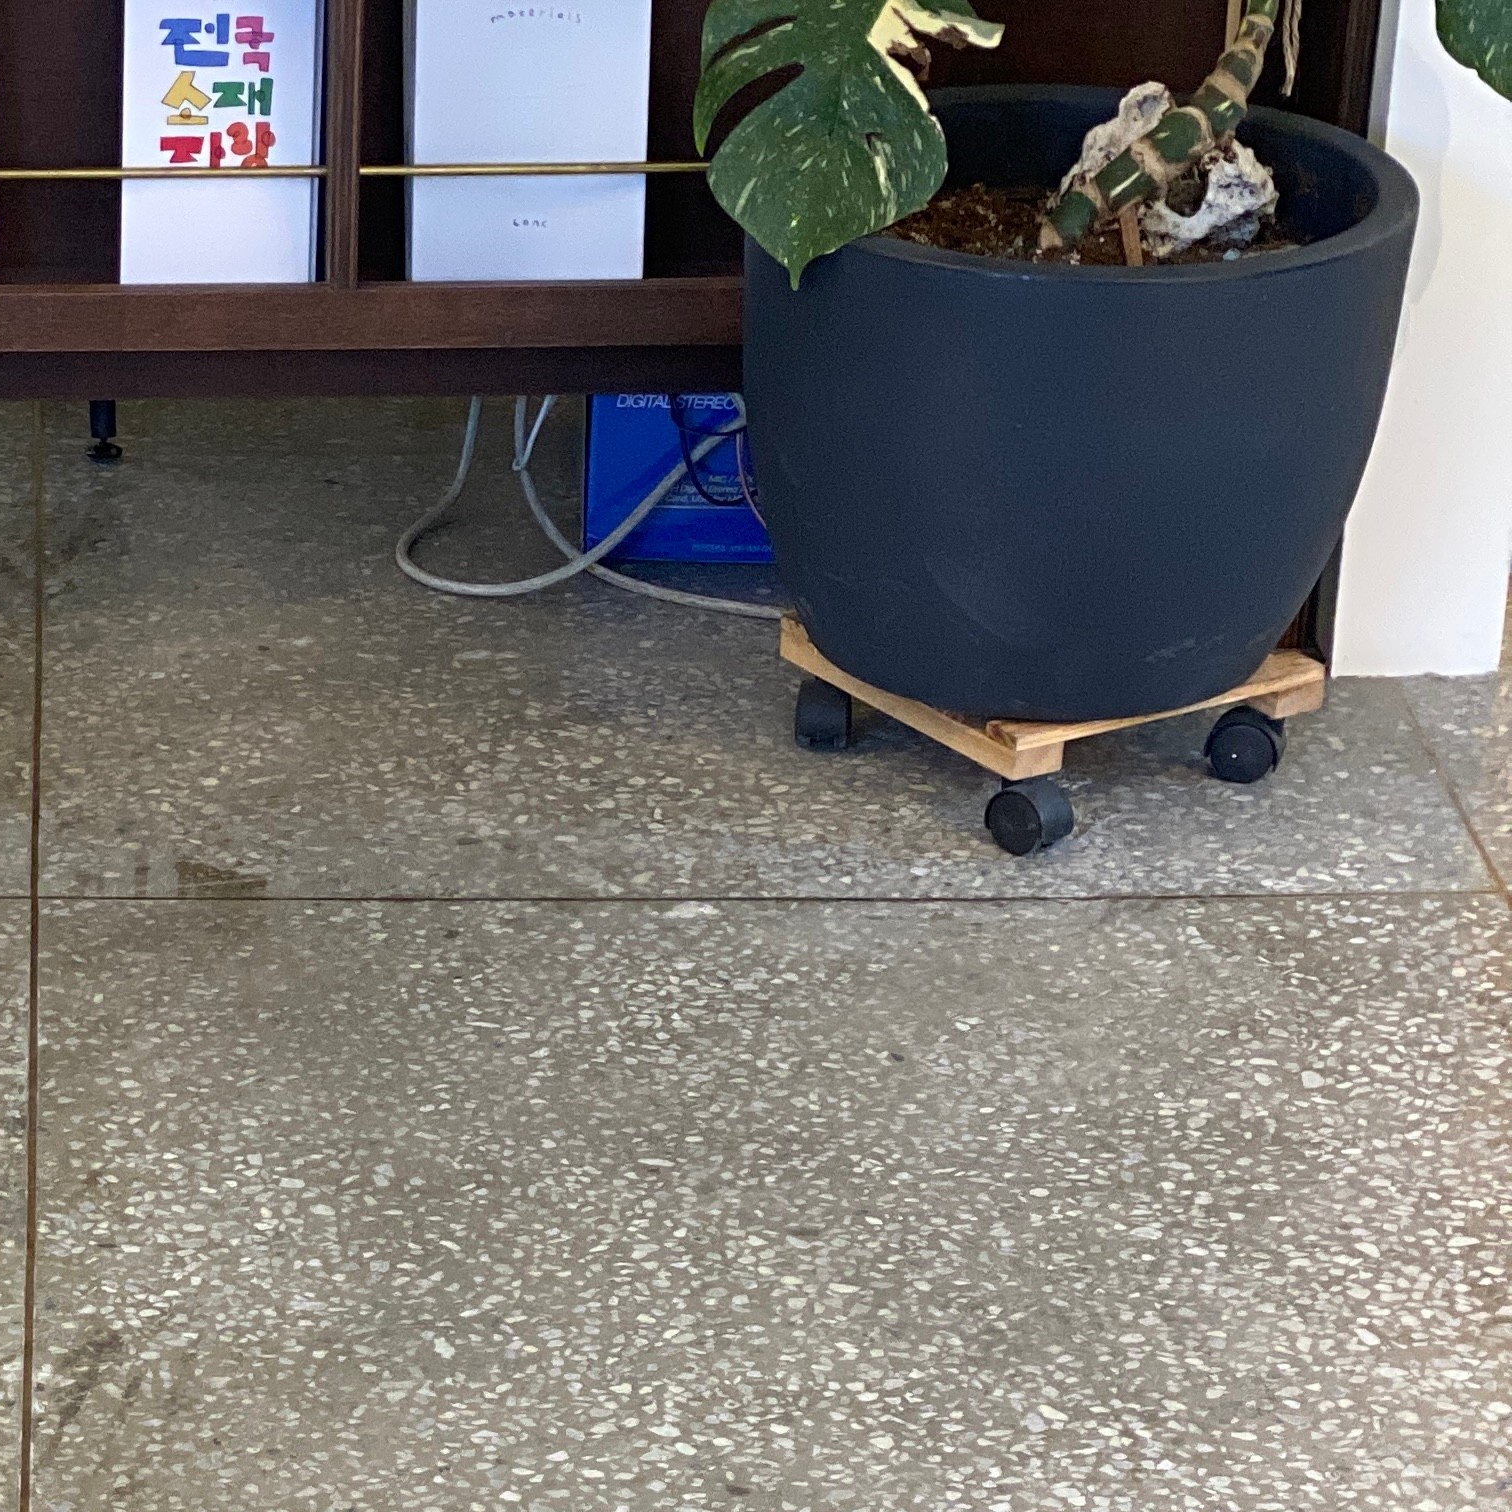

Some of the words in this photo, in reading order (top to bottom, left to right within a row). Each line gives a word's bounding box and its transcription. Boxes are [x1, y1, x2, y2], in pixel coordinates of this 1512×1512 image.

[491, 7, 581, 23] materials
[159, 13, 276, 73] 전국
[161, 71, 275, 126] 소재
[159, 122, 277, 169] 자랑
[616, 393, 671, 409] DIGITAL
[675, 394, 738, 410] STEREO
